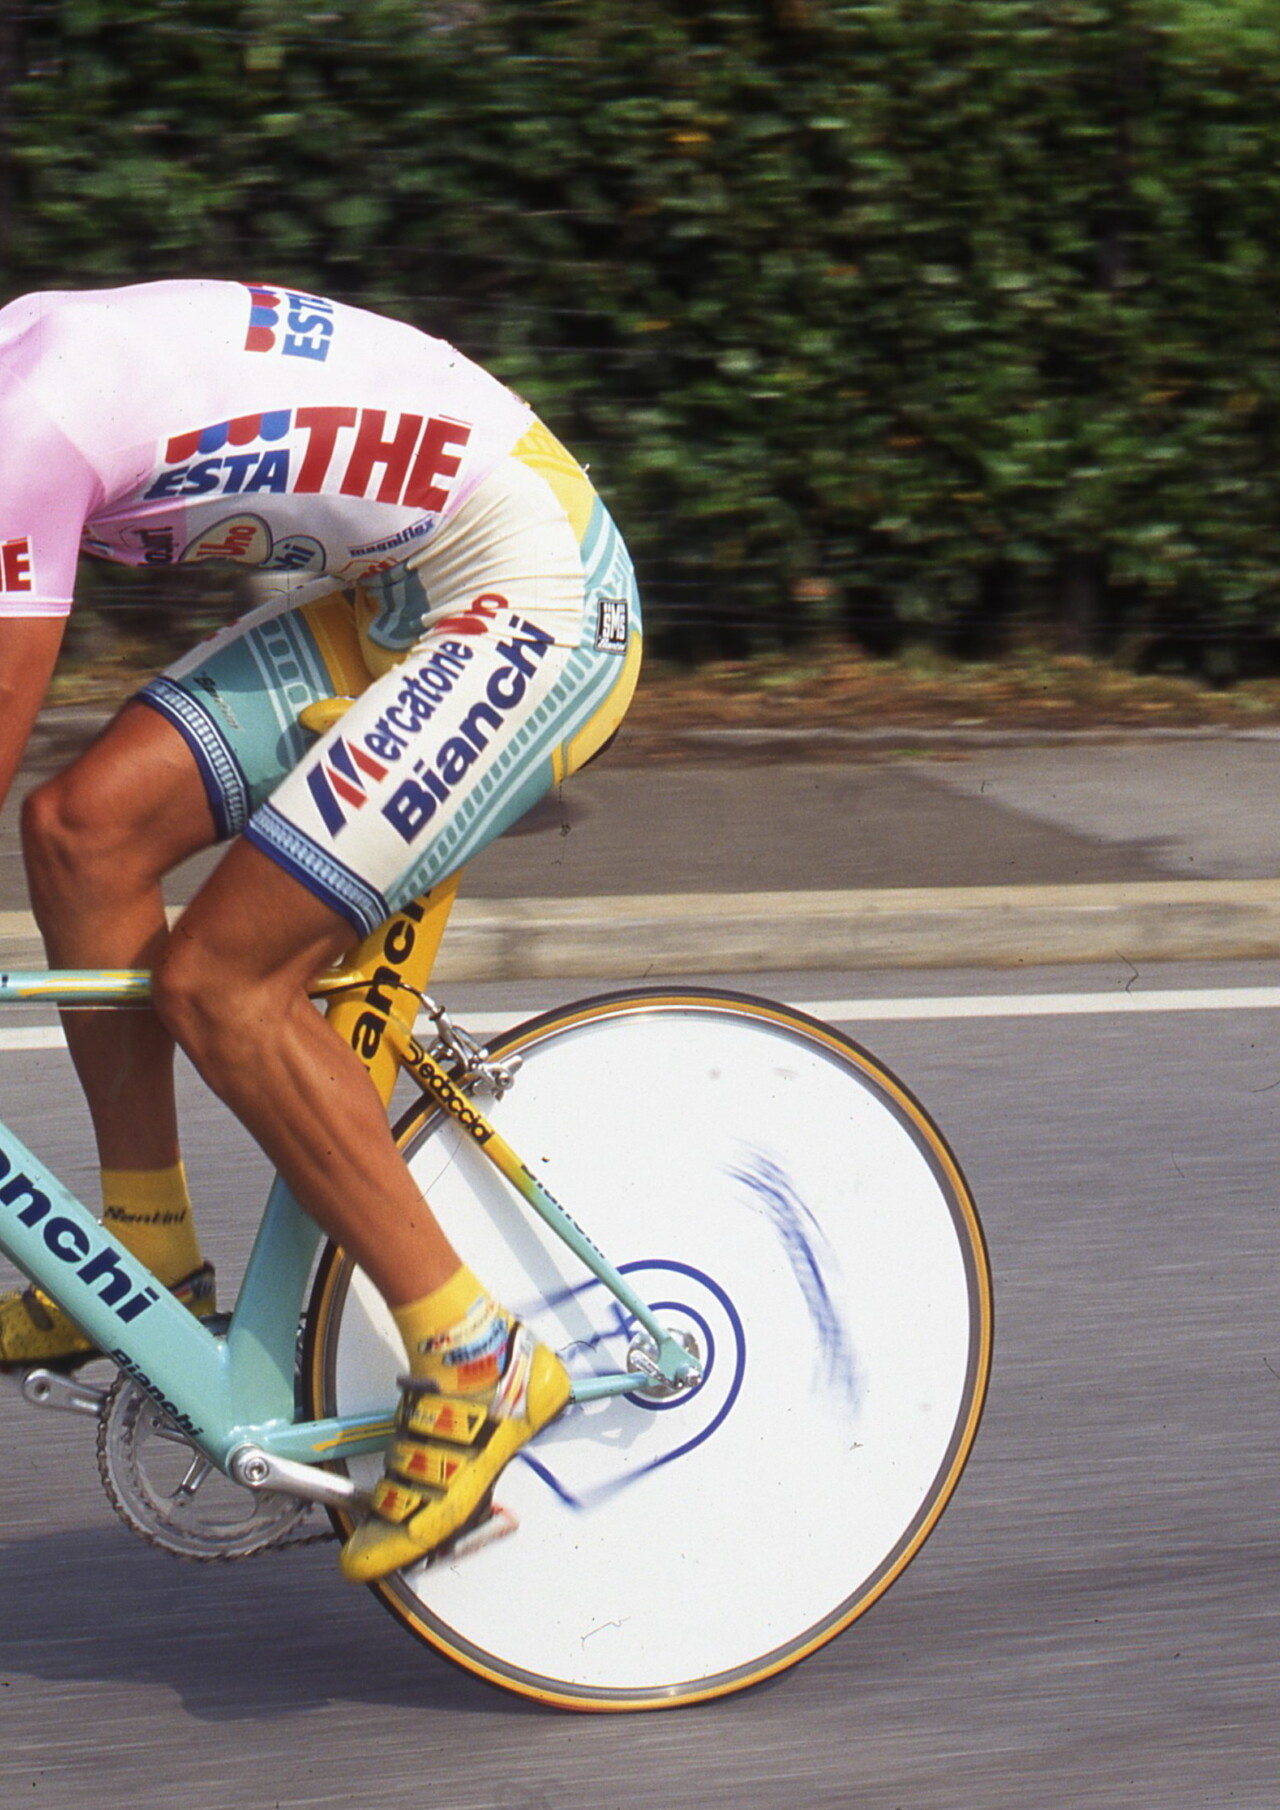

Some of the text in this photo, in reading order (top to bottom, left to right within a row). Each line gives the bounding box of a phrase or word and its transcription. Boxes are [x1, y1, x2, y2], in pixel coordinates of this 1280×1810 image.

[143, 449, 291, 500] ESTA
[381, 613, 556, 845] Bianchi
[111, 1348, 204, 1439] Bianchi
